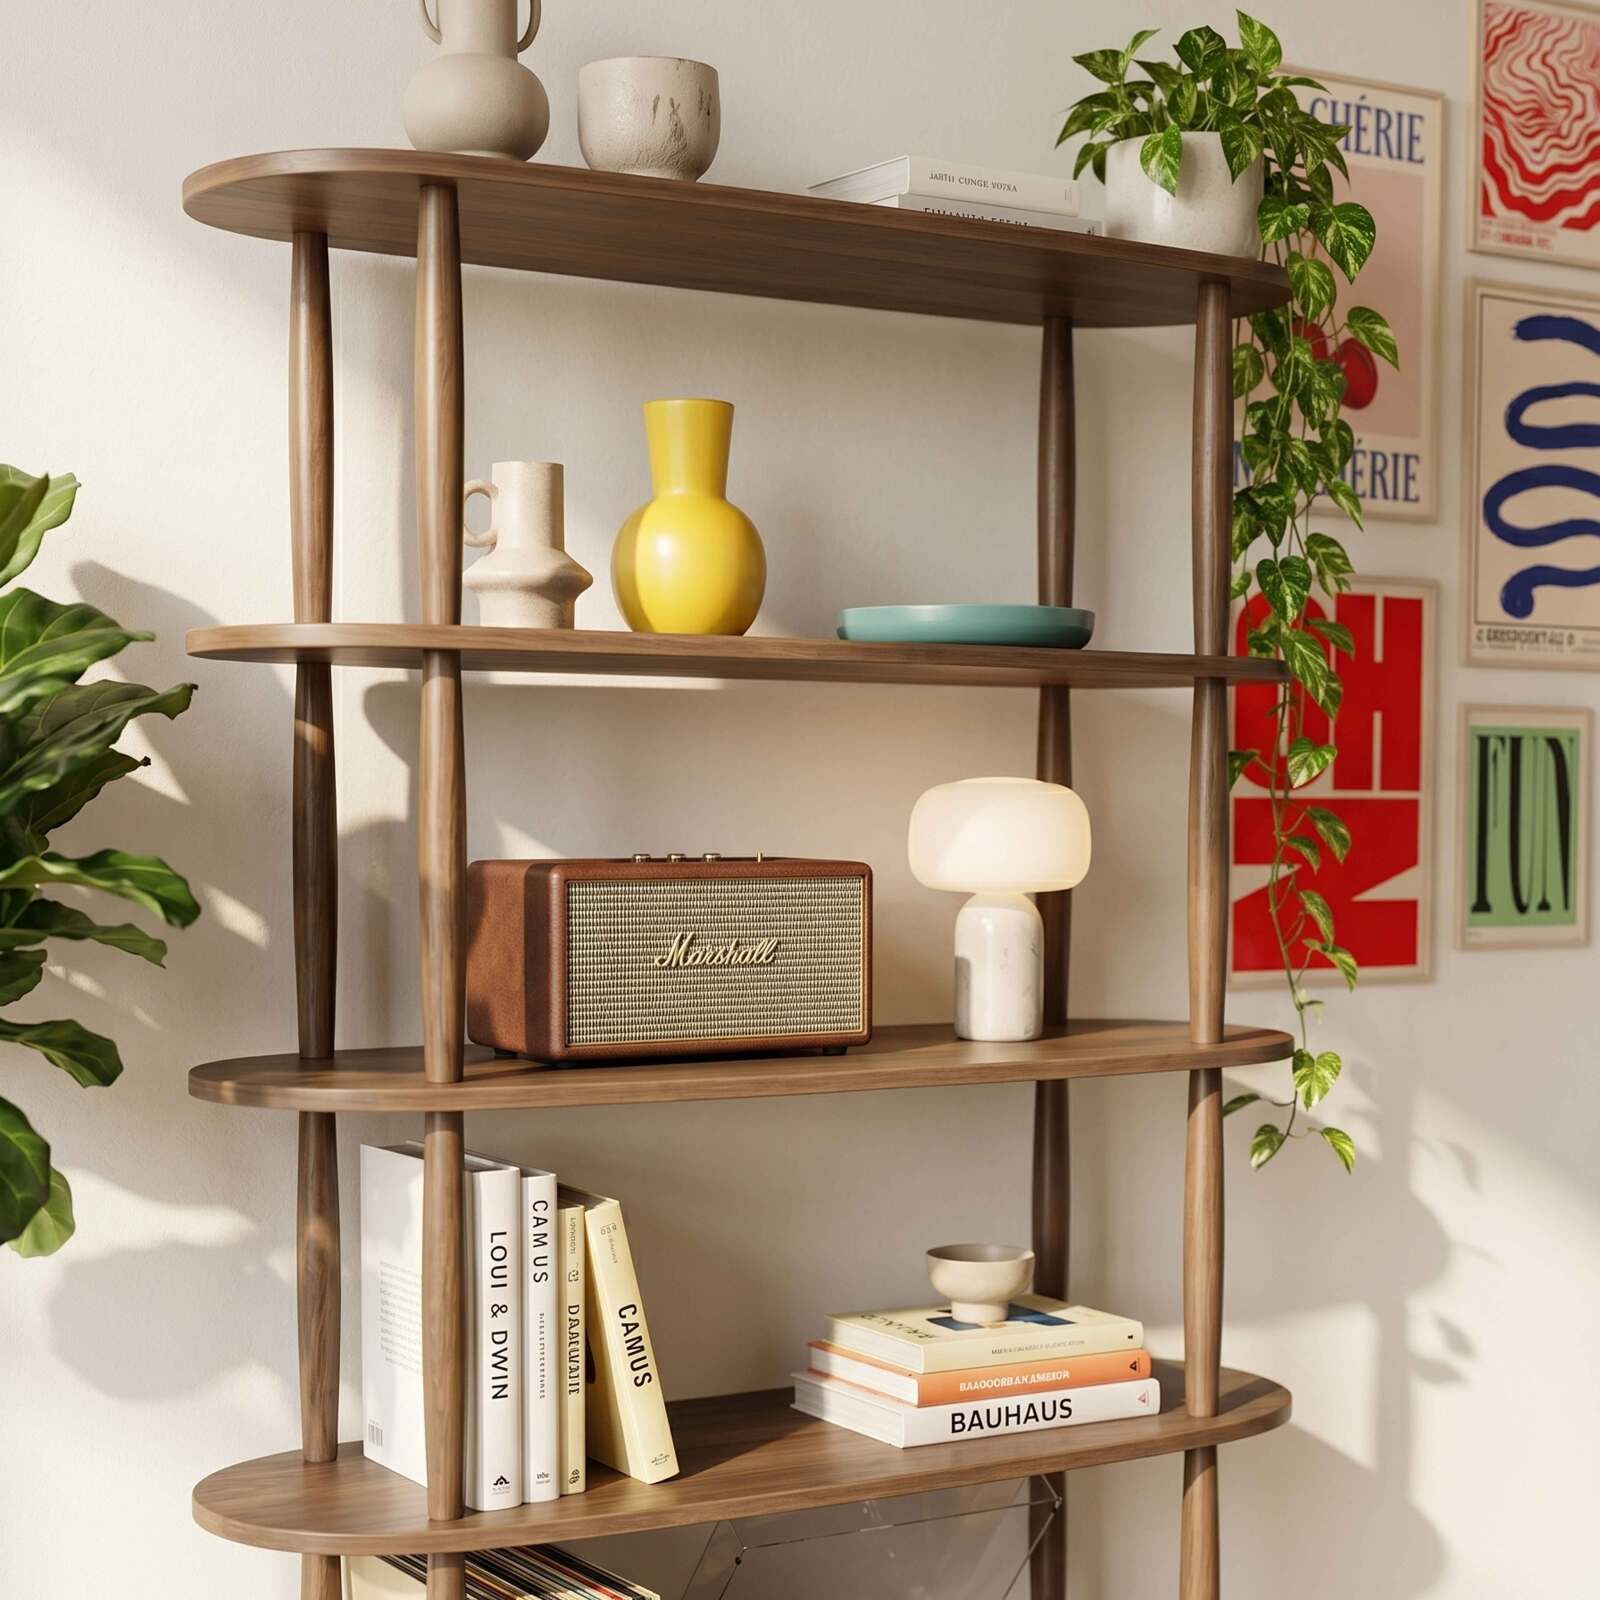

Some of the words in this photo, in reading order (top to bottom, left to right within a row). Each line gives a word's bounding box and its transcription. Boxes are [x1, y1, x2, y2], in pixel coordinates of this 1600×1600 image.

[1337, 438, 1420, 503] ÉRIE
[1471, 735, 1576, 915] FUN
[654, 931, 779, 968] Marshall
[490, 1231, 508, 1289] LOUI
[532, 1200, 549, 1284] CAMUS
[490, 1303, 508, 1319] &
[491, 1330, 509, 1400] DWIN
[618, 1303, 653, 1388] CAMUS
[950, 1398, 1073, 1434] BAUHAUS
